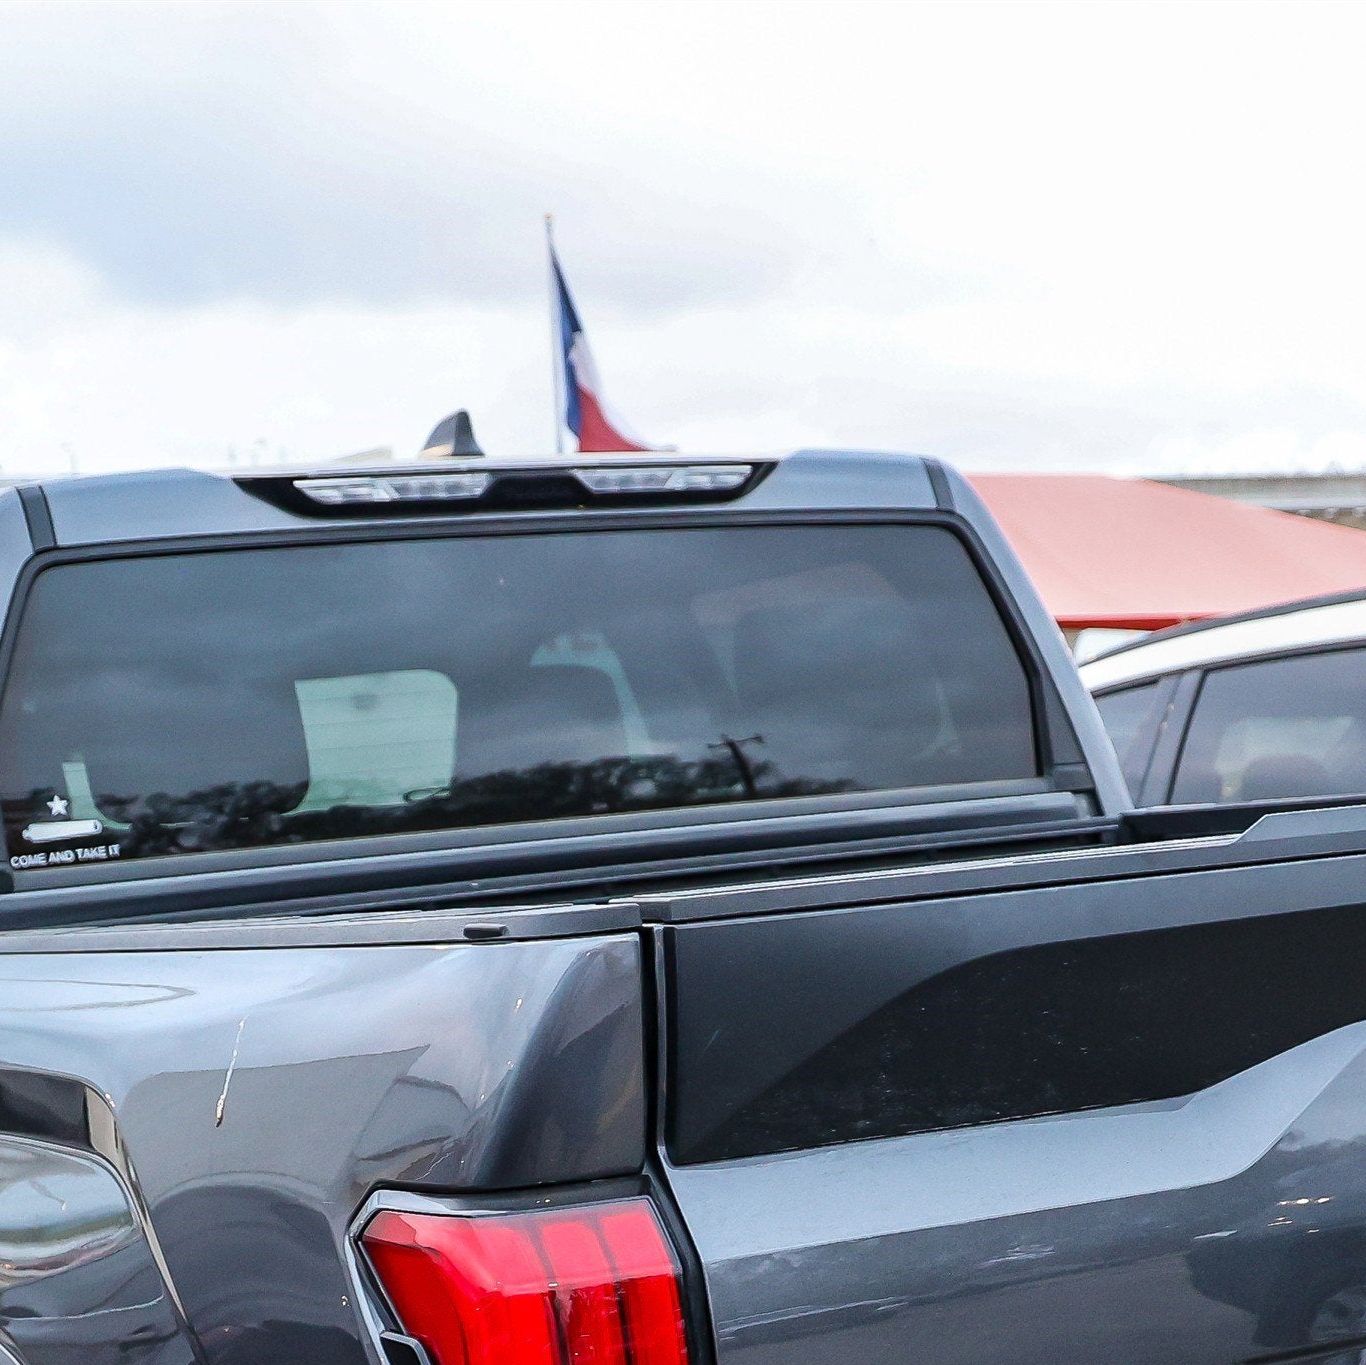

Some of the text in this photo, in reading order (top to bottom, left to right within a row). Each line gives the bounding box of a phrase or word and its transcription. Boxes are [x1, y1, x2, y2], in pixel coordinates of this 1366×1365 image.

[11, 844, 120, 868] COME AND TAKE IT
